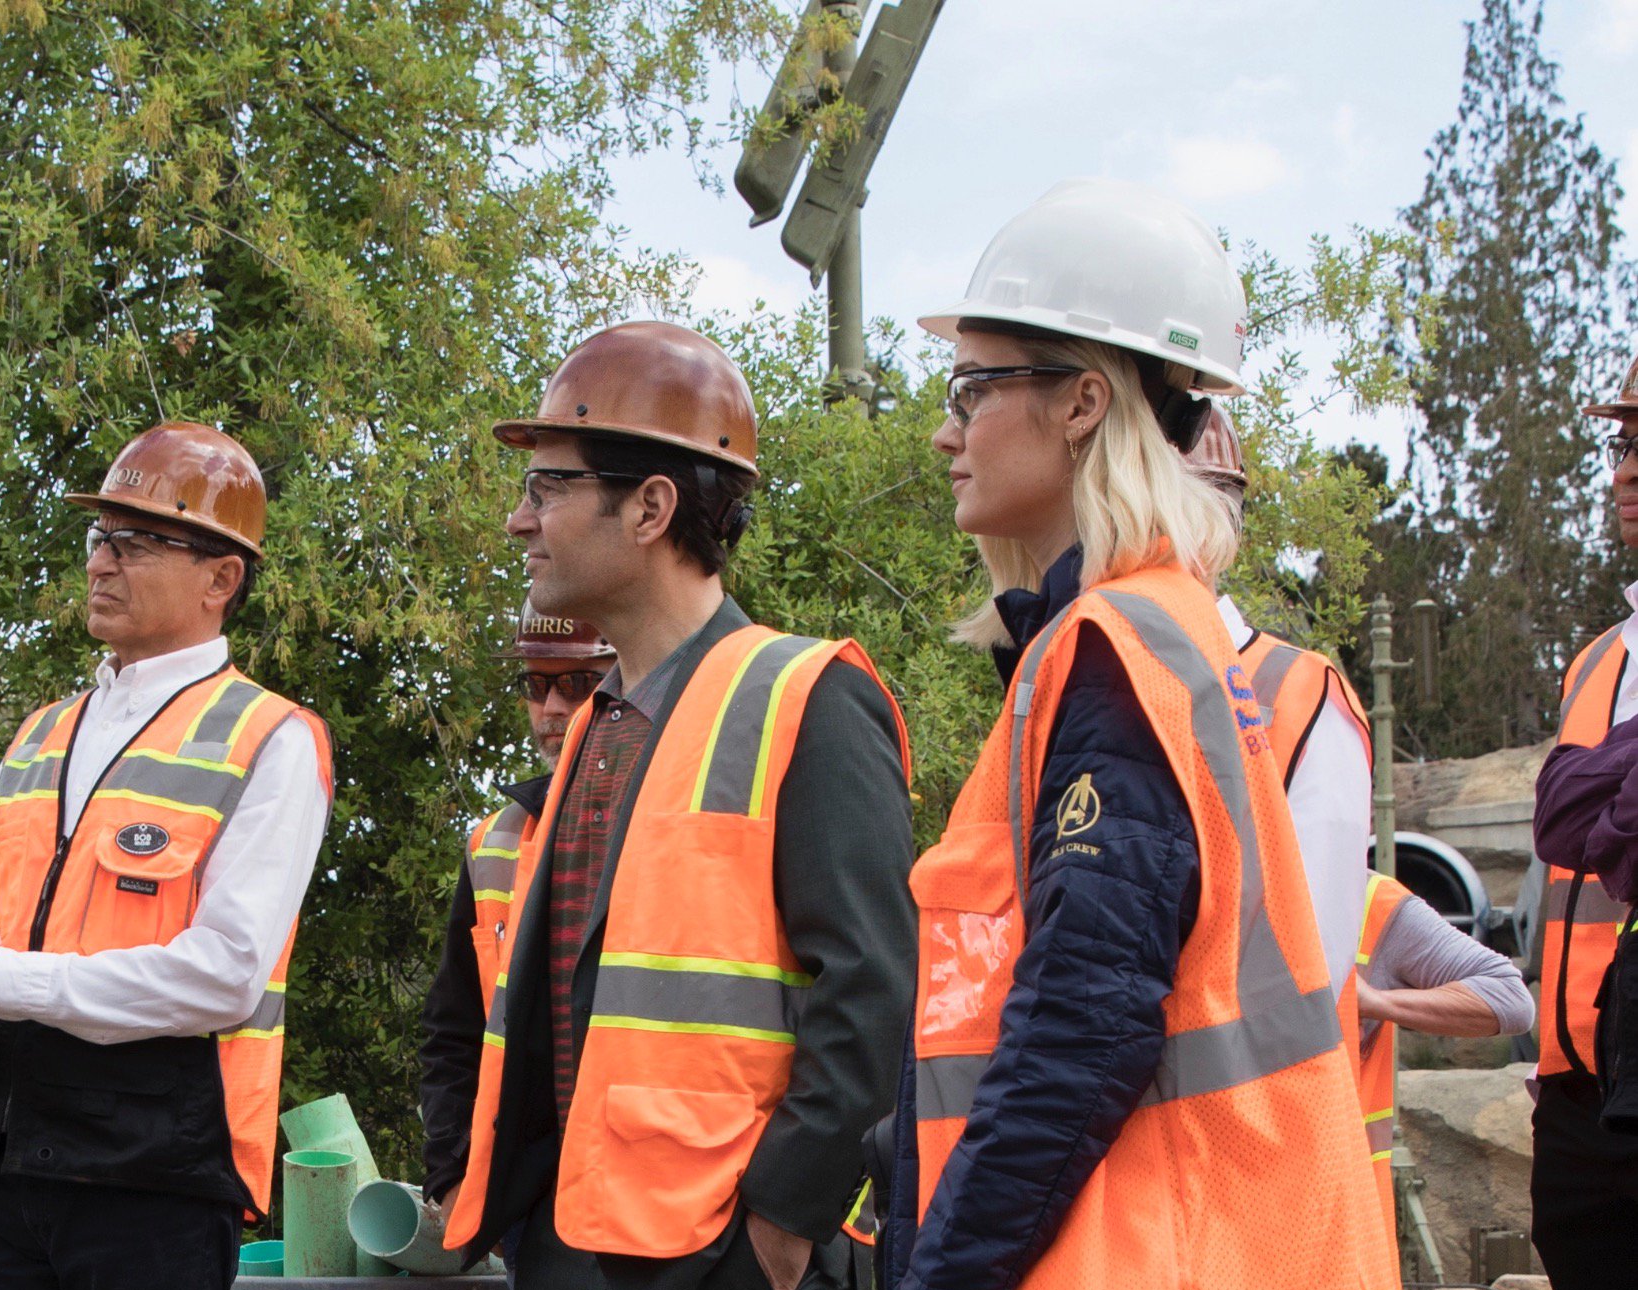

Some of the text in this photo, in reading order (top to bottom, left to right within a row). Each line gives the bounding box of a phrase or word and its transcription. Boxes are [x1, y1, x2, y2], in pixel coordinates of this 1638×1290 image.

[1169, 333, 1196, 350] MSA
[522, 617, 574, 635] CHRIS
[1066, 843, 1101, 857] CREW
